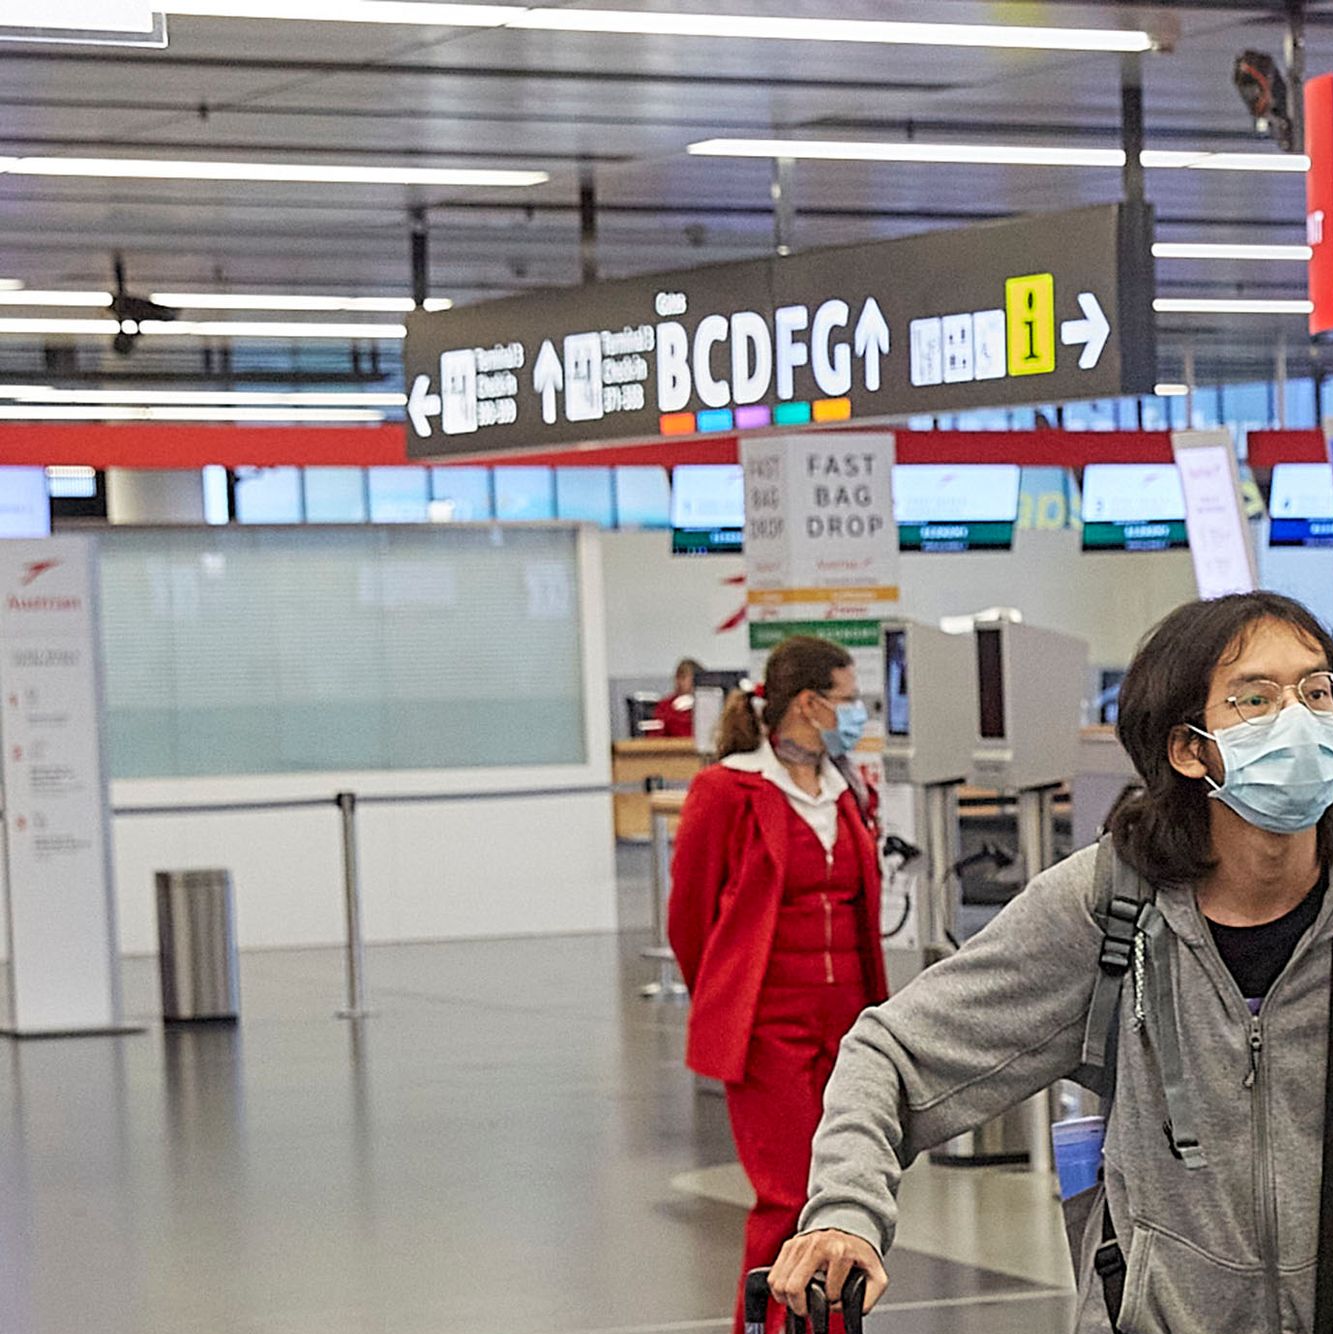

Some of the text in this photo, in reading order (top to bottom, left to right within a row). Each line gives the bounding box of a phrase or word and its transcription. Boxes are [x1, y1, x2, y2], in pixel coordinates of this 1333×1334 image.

[806, 453, 876, 477] FAST
[815, 484, 873, 508] BAG
[806, 514, 883, 538] DROP
